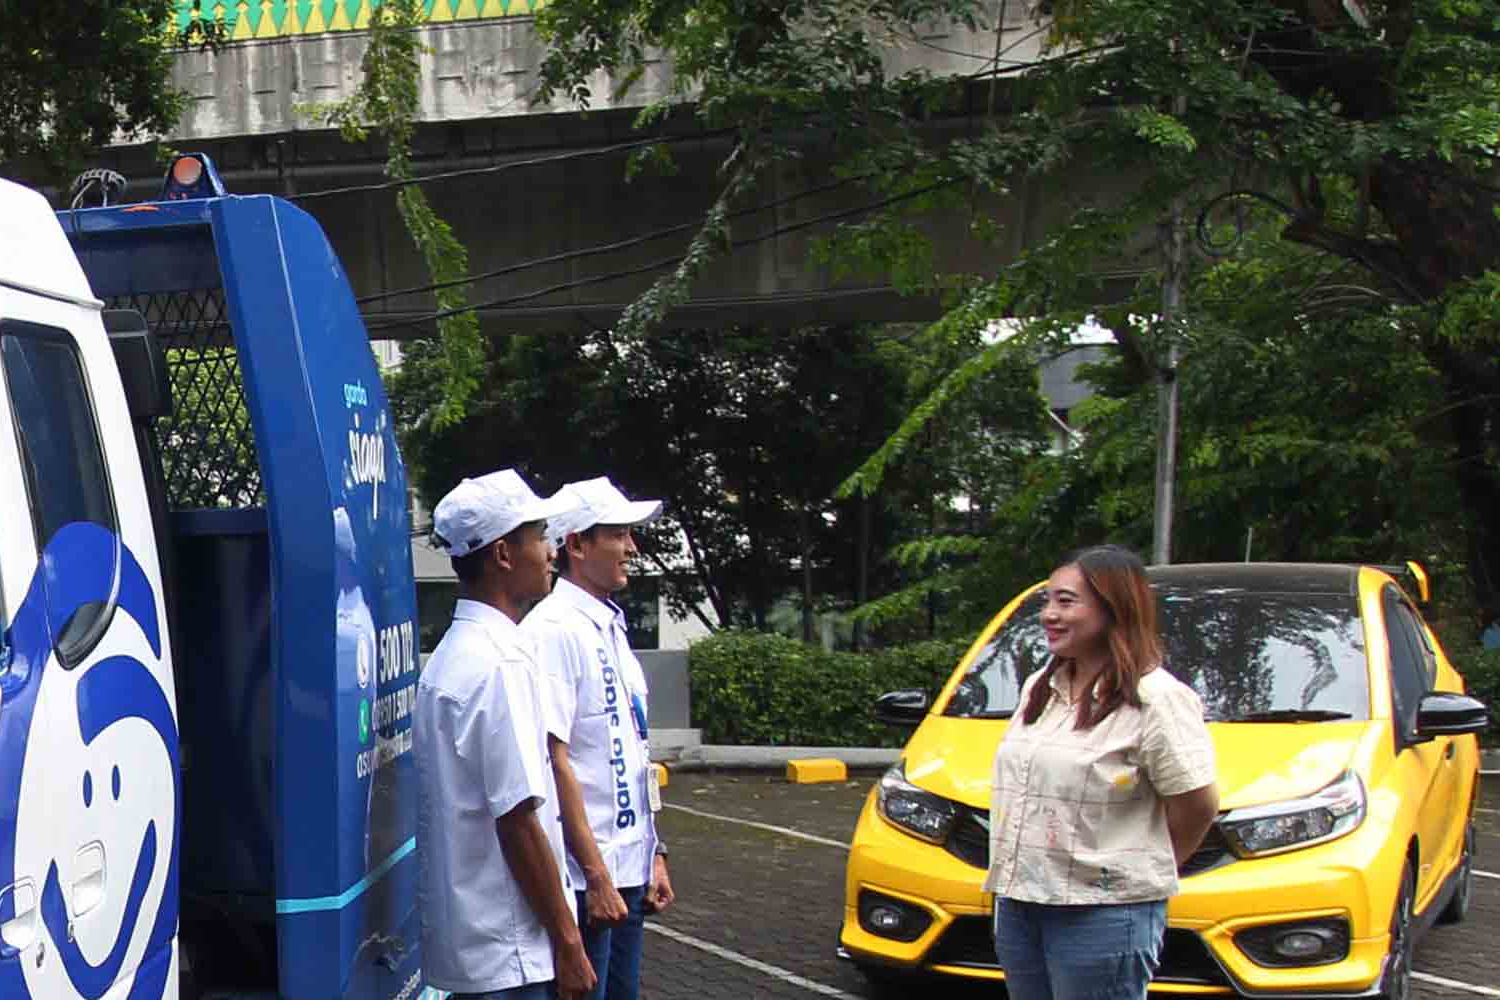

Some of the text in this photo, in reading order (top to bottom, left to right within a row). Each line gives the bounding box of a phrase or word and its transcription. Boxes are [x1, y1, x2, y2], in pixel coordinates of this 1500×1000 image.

[344, 379, 368, 408] garda
[348, 412, 386, 520] siaga
[380, 626, 400, 684] 500
[596, 648, 636, 830] garda siaga
